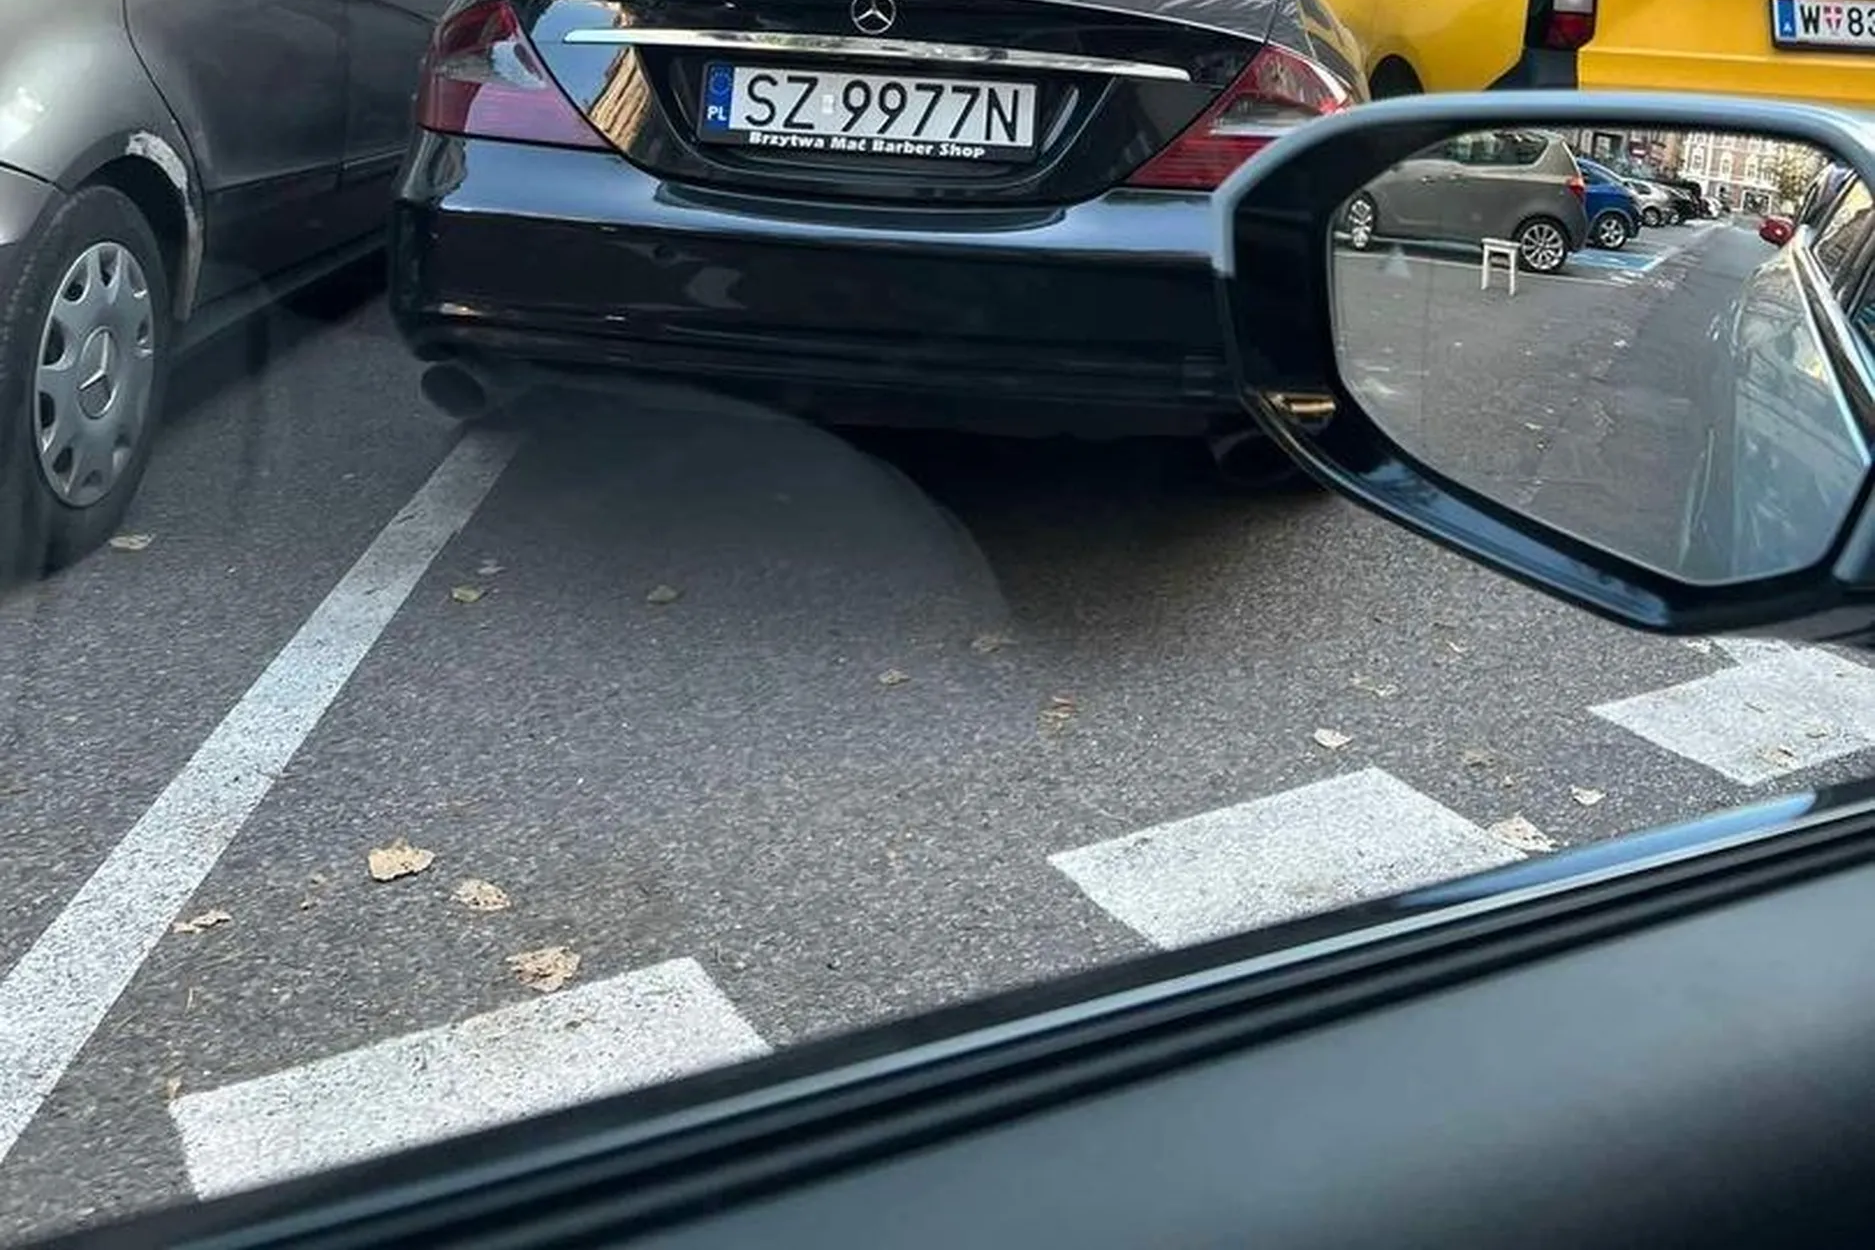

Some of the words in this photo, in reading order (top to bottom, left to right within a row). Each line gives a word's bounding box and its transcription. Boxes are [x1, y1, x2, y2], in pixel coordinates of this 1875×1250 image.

[1799, 4, 1821, 35] W
[707, 106, 728, 122] PL
[745, 74, 819, 130] SZ
[842, 80, 1020, 142] 9977N
[749, 131, 826, 151] Brzytwa
[872, 139, 933, 156] Barber
[939, 142, 985, 158] Shop
